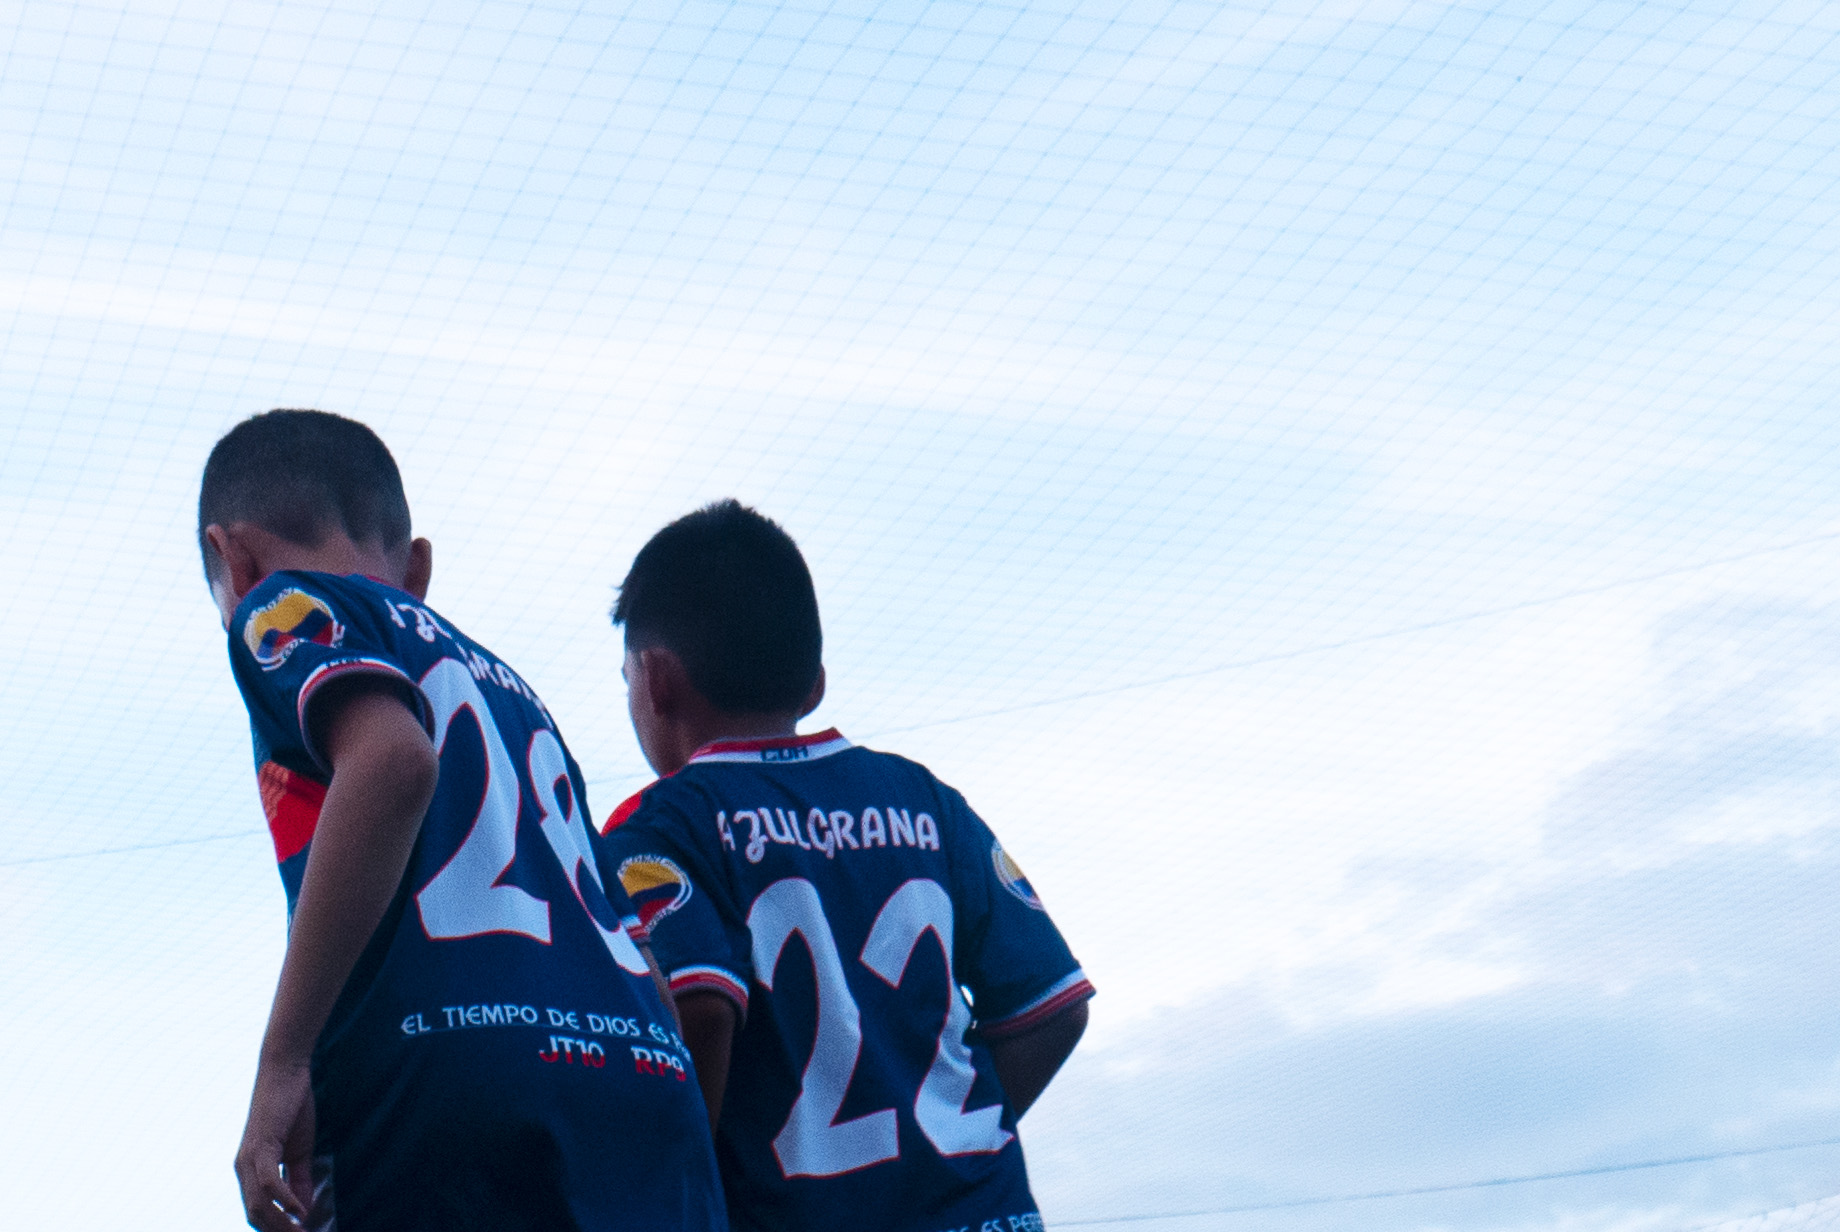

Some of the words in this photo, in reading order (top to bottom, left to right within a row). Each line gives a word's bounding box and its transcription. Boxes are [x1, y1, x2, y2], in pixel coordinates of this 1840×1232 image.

[716, 806, 940, 864] AZULGRANA
[400, 1012, 431, 1035] EL
[442, 1003, 538, 1028] TIEMPO
[546, 1007, 580, 1031] DE
[586, 1013, 641, 1037] DIOS
[648, 1022, 670, 1045] ES
[746, 876, 1016, 1180] 22
[538, 1034, 606, 1069] JT10
[630, 1045, 687, 1083] RP9
